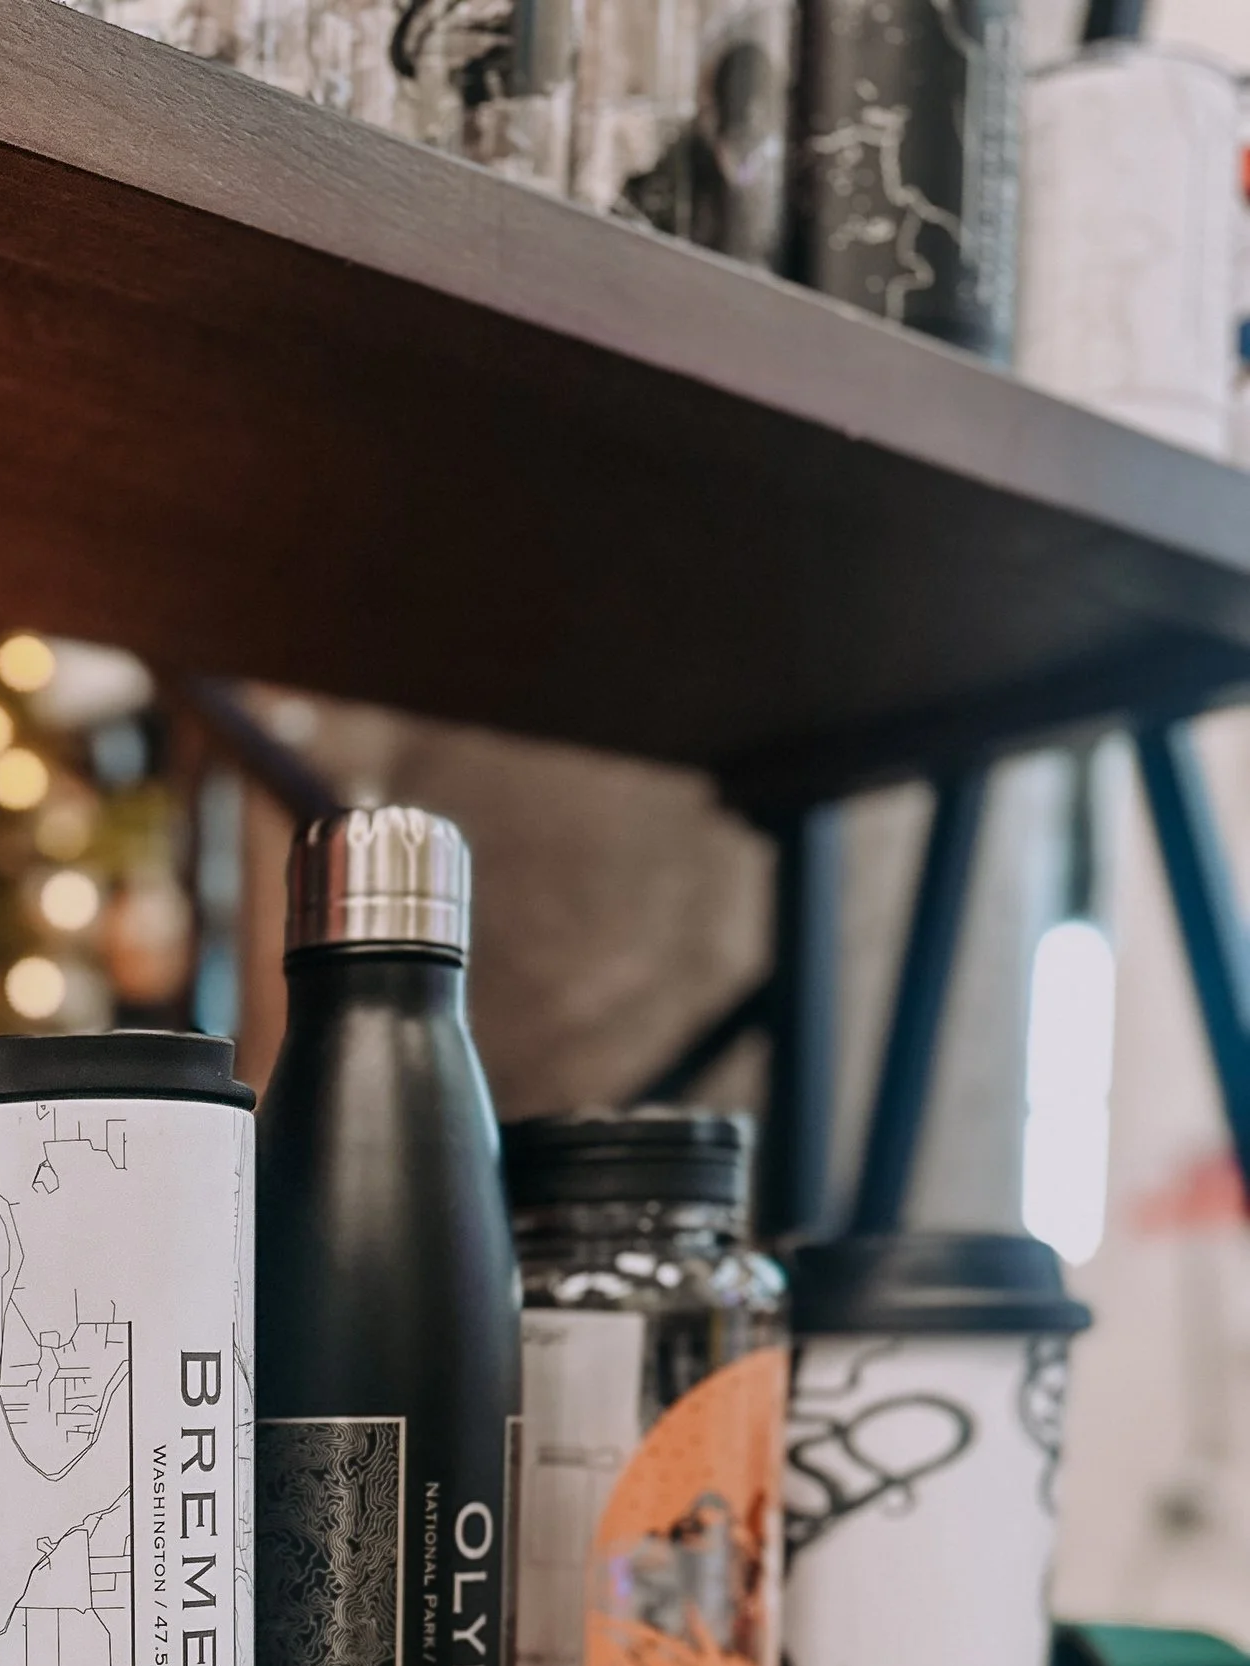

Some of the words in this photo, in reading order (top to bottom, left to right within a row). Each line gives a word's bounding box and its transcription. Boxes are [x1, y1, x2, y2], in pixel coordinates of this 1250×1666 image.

[152, 1443, 167, 1592] WASHINGTON
[423, 1481, 441, 1587] NATIONAL
[422, 1593, 439, 1649] PARK
